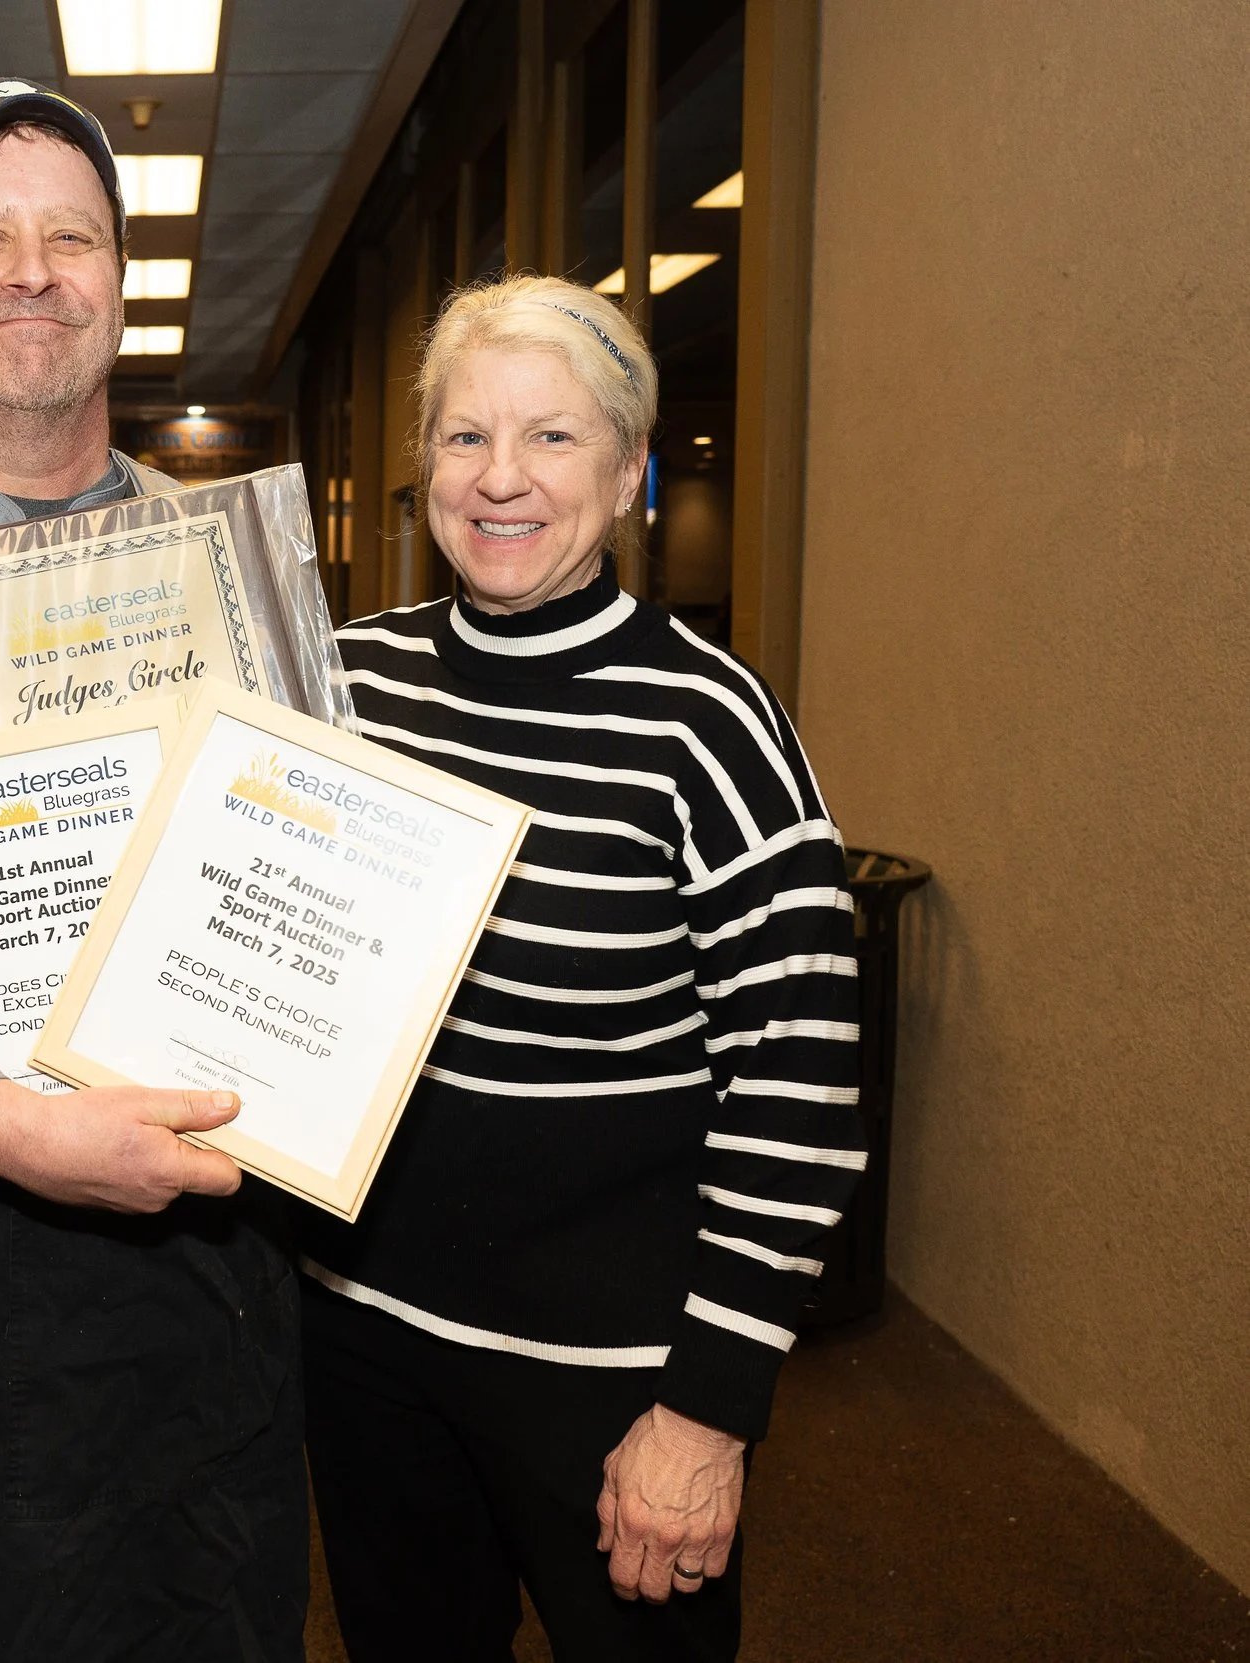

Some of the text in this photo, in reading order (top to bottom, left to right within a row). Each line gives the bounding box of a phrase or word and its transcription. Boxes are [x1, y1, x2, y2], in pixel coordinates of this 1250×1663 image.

[44, 579, 183, 623] easterseals
[109, 603, 187, 629] Bluegrass
[11, 623, 192, 669] WILD GAME DINNER
[12, 650, 209, 725] Judges Circle
[43, 785, 130, 811] Bluegrass
[57, 807, 134, 833] DINNER
[287, 769, 445, 848] easterseals
[29, 851, 94, 876] Annual
[224, 794, 424, 892] WILD GAME DINNER
[344, 817, 433, 868] Bluegrass
[200, 862, 384, 957] Wild Game Dinner &
[250, 857, 355, 914] 21st Annual
[44, 927, 62, 944] 7,
[67, 921, 90, 939] 20
[207, 916, 339, 986] March 7, 2025
[219, 894, 345, 961] Sport Auction
[166, 949, 342, 1041] PEOPLE'S CHOICE
[192, 1060, 220, 1077] Jamie
